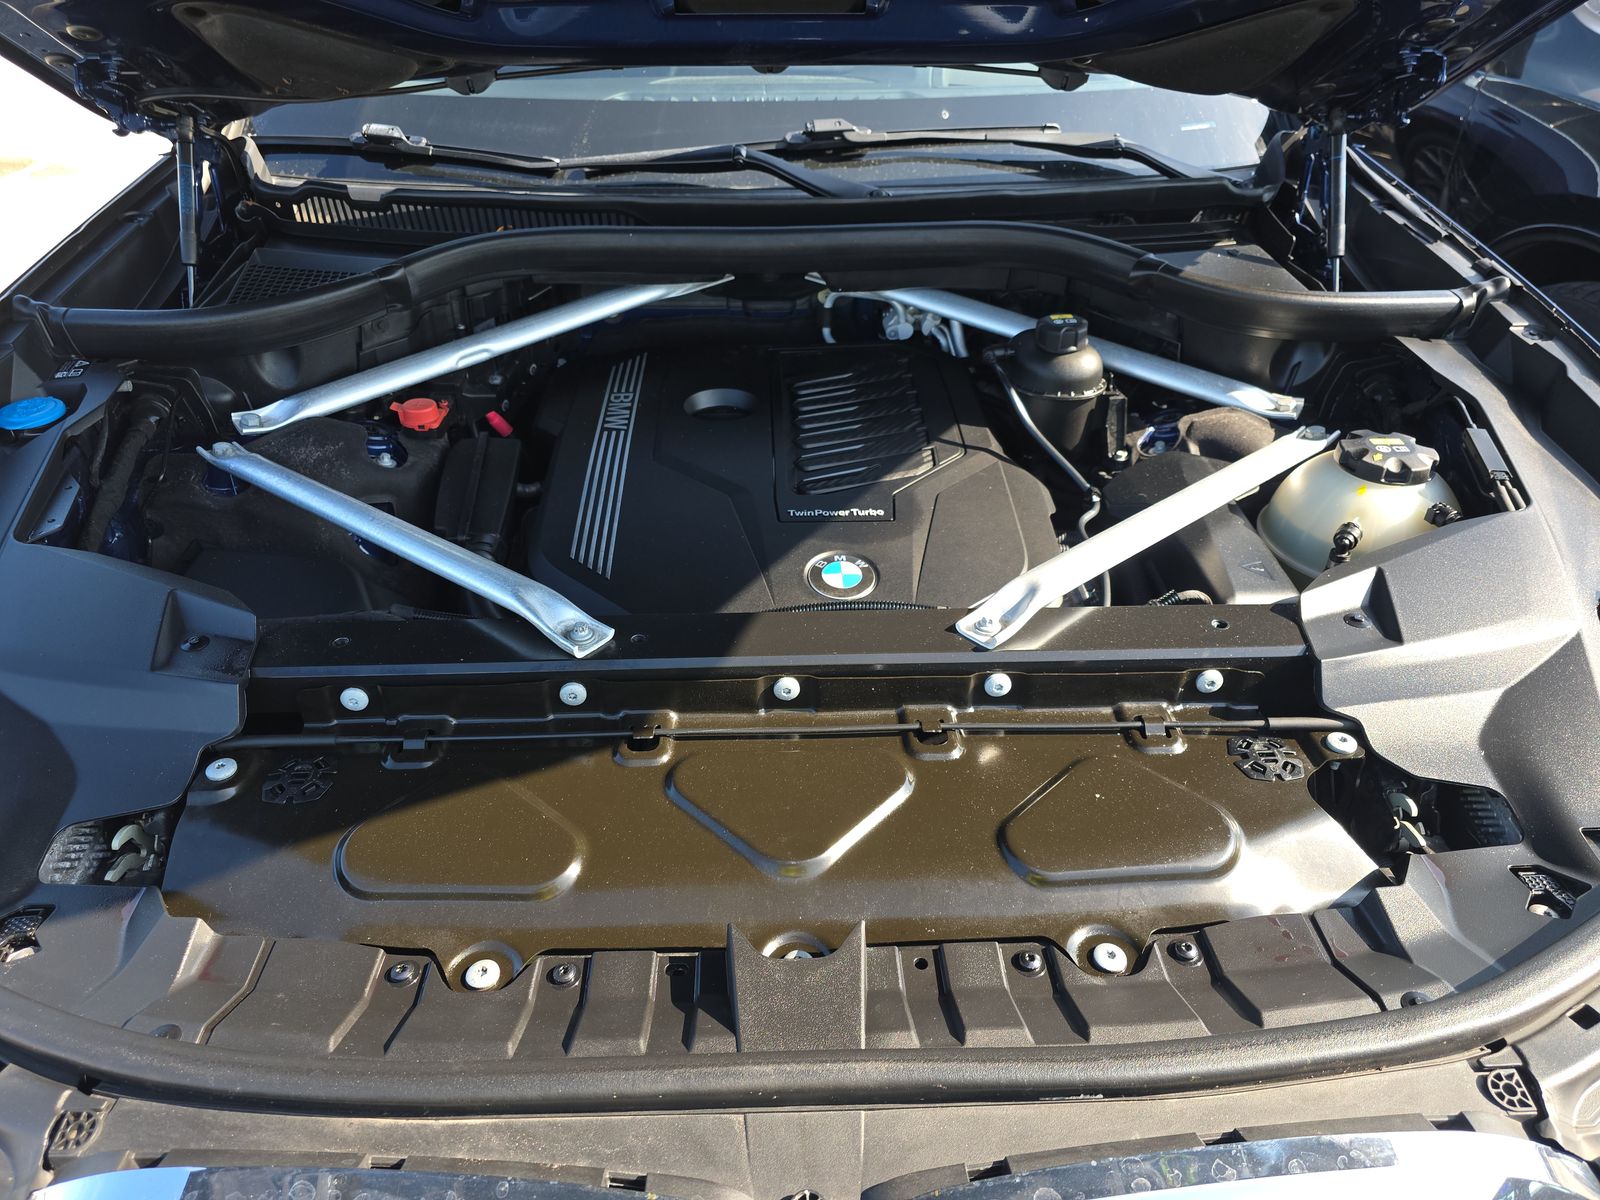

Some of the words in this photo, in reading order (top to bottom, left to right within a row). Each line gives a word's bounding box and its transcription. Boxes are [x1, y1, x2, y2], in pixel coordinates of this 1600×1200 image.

[604, 393, 634, 429] BMW
[850, 508, 885, 516] Turbo
[815, 555, 869, 569] BMW
